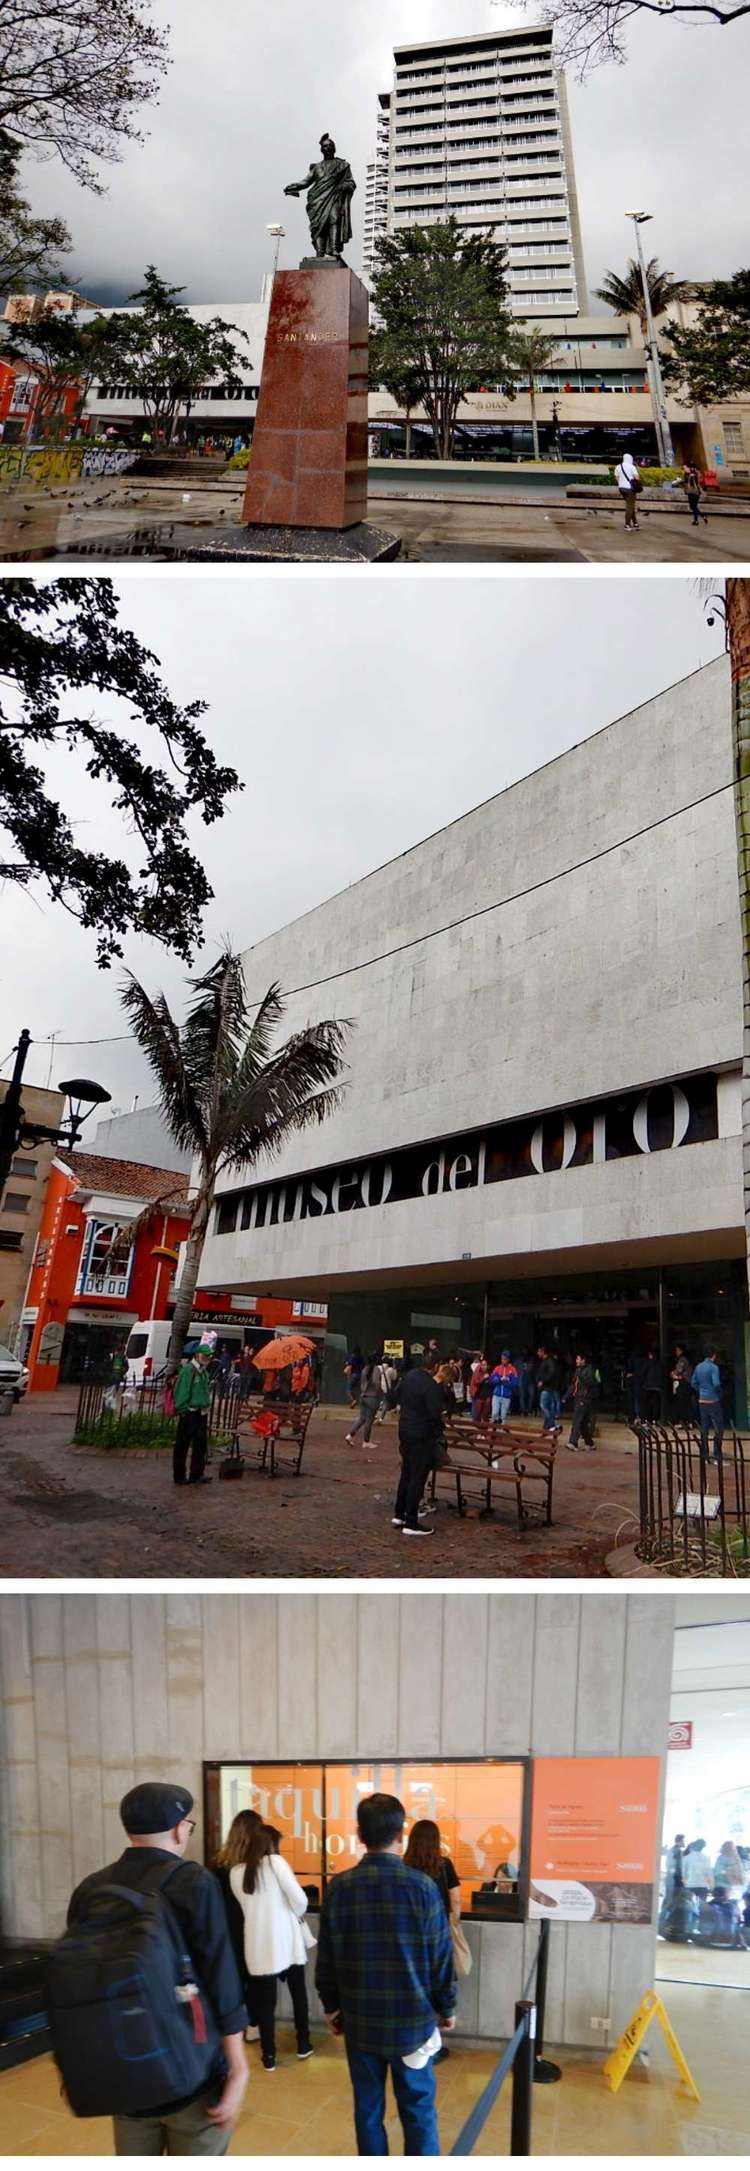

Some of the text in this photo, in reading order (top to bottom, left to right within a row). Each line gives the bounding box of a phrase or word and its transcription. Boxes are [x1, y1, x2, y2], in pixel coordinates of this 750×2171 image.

[235, 1084, 690, 1232] museo del oro
